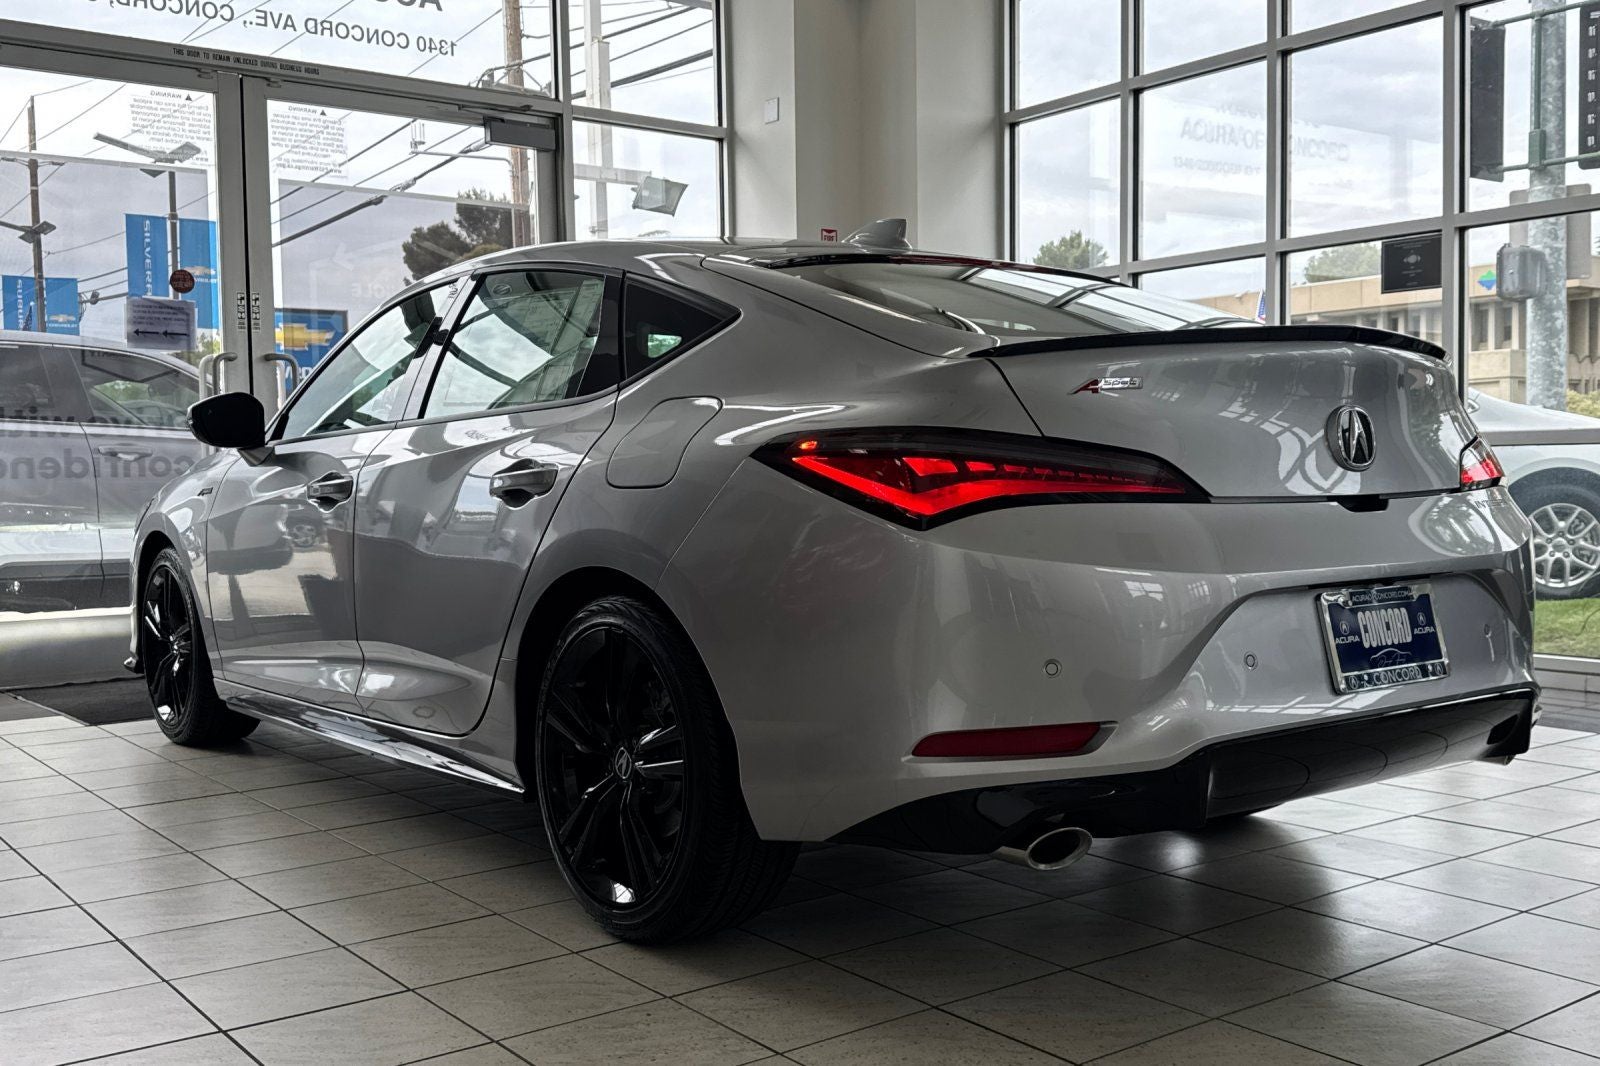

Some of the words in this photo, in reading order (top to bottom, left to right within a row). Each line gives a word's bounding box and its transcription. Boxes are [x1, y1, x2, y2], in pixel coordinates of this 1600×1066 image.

[173, 48, 184, 56] THIS
[187, 49, 200, 58] DOOR
[212, 53, 231, 62] REMAIN
[233, 56, 258, 66] UNLOCKED
[260, 60, 278, 69] DURING
[279, 62, 302, 73] BUSINESS
[304, 66, 320, 75] HOURS
[237, 293, 246, 319] PUSH
[252, 293, 260, 320] PUSH
[1336, 635, 1360, 644] ACURA
[1357, 607, 1412, 648] CONCORD
[1414, 626, 1436, 635] ACURA
[1374, 666, 1422, 685] CONCORD
